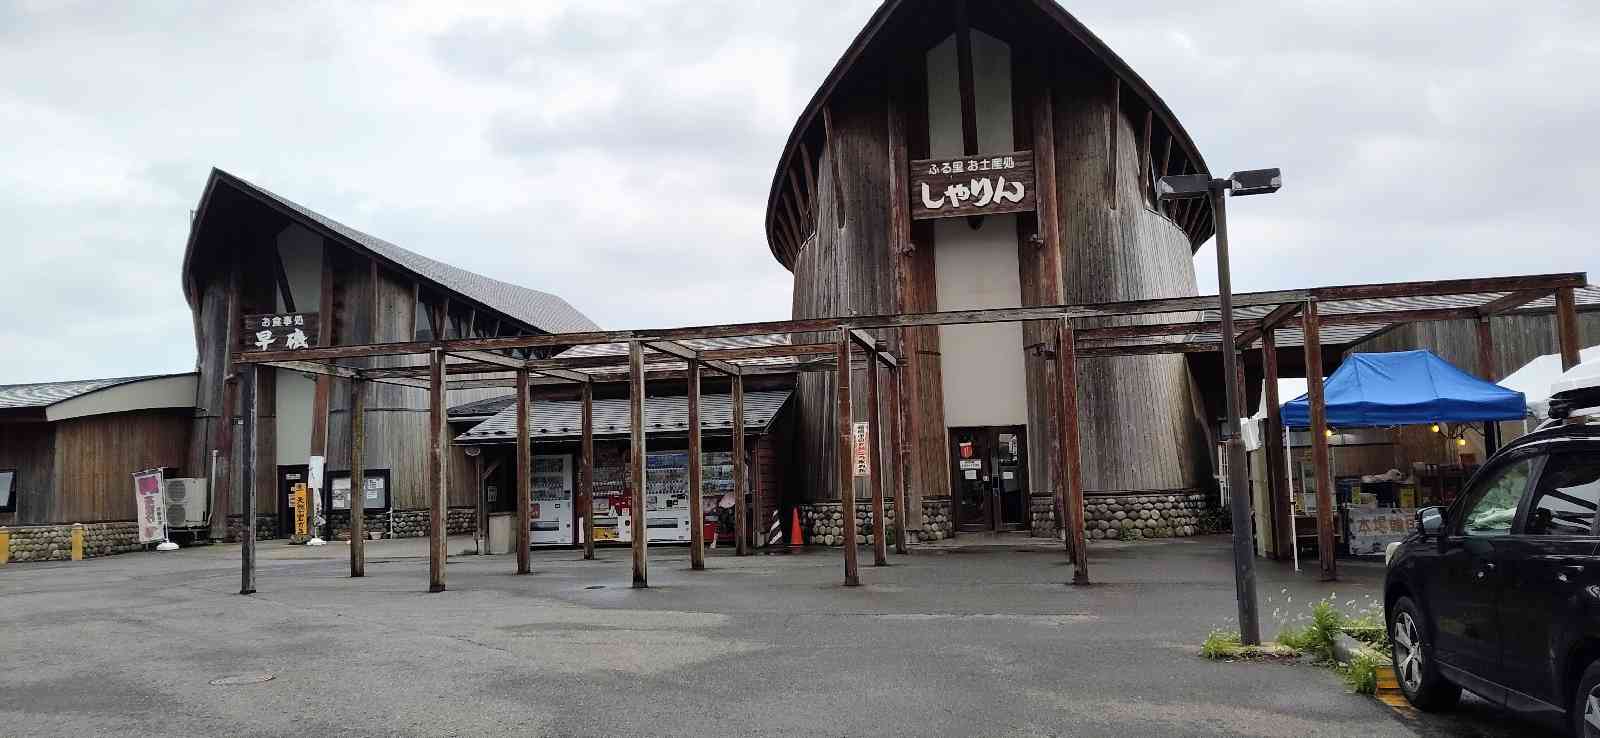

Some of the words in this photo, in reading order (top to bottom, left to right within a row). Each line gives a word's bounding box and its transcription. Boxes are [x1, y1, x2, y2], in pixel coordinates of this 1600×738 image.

[928, 160, 964, 175] ふる里
[967, 156, 1015, 172] お土産処
[921, 175, 1025, 209] しゃりん
[261, 315, 304, 327] お食事処
